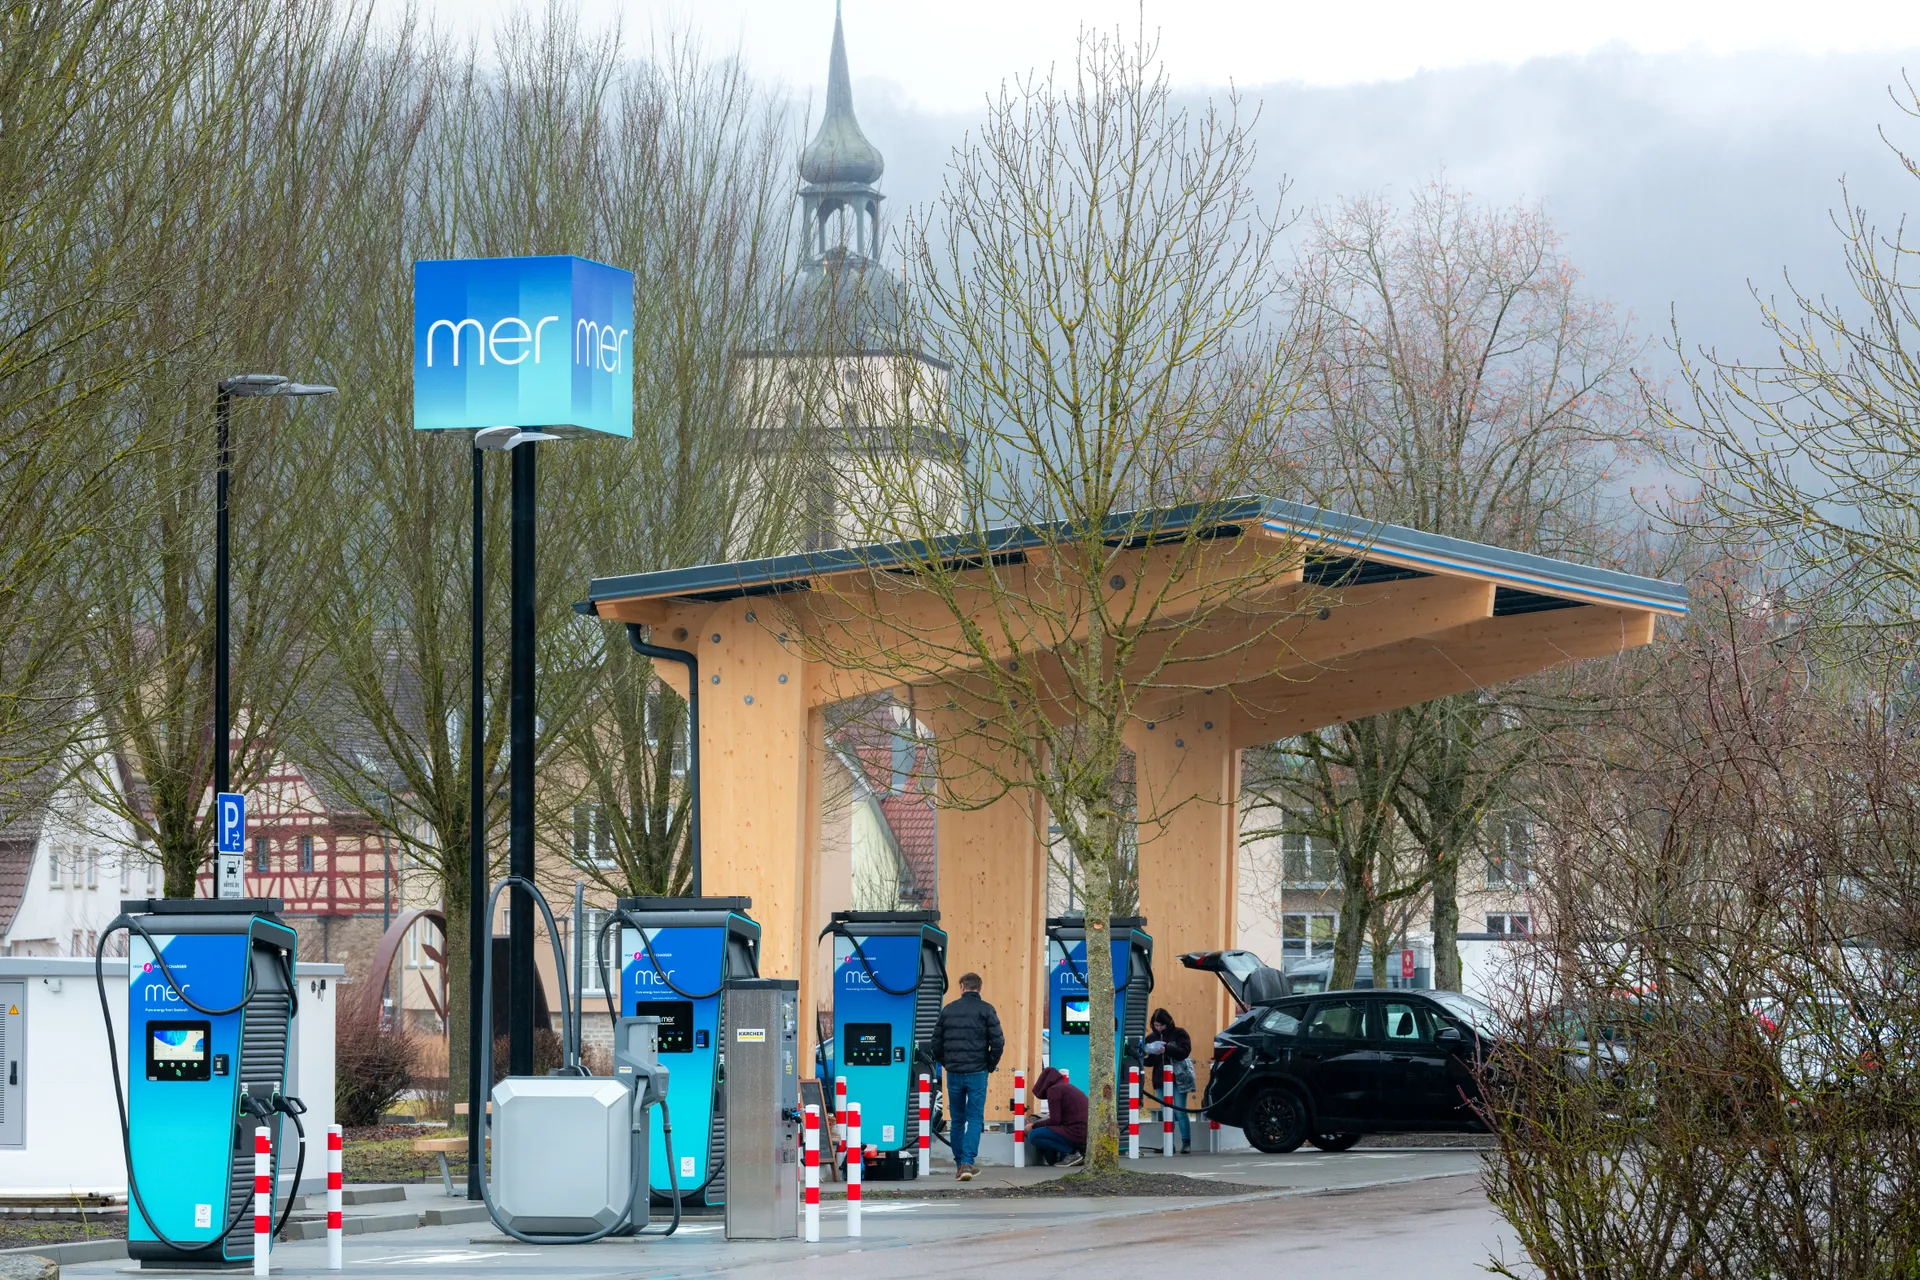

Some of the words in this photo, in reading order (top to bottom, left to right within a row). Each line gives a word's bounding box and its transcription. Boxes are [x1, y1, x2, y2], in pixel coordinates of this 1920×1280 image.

[427, 315, 559, 367] mer
[576, 317, 628, 374] mer
[225, 802, 239, 844] P
[145, 984, 190, 1001] mer
[636, 970, 675, 984] mer
